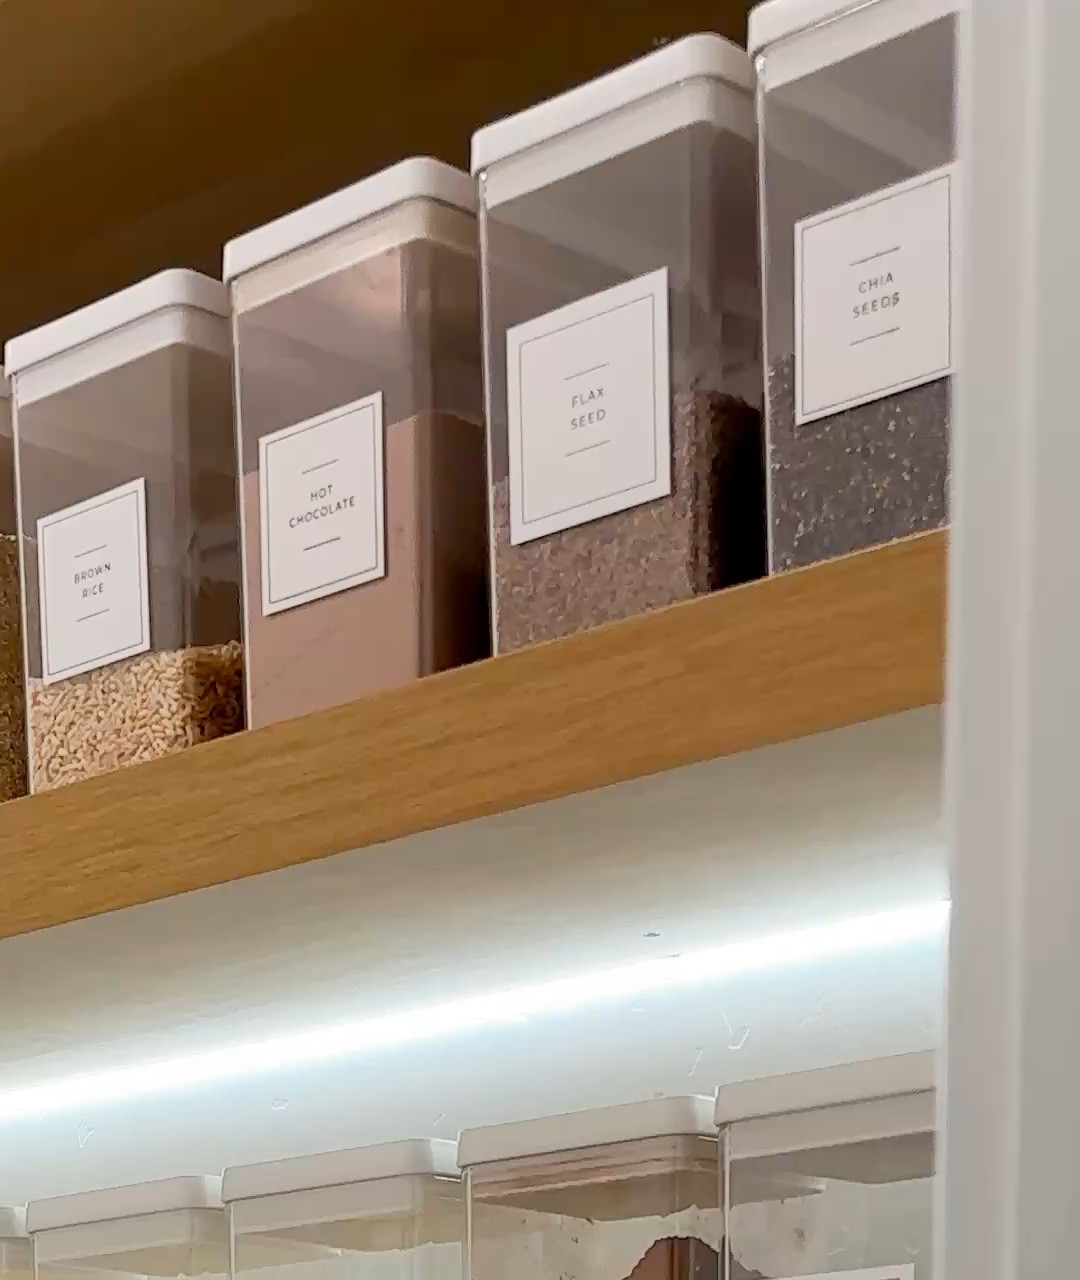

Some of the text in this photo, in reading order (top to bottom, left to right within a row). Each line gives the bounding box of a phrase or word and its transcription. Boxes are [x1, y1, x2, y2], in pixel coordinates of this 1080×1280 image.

[857, 271, 898, 297] CHIA
[852, 289, 900, 319] SEEDS
[571, 387, 606, 412] FLAX
[570, 405, 607, 431] SEED
[310, 483, 333, 502] HOT
[288, 492, 355, 529] CHOCOLATE
[73, 562, 112, 586] BROWN
[78, 579, 104, 599] RICE
